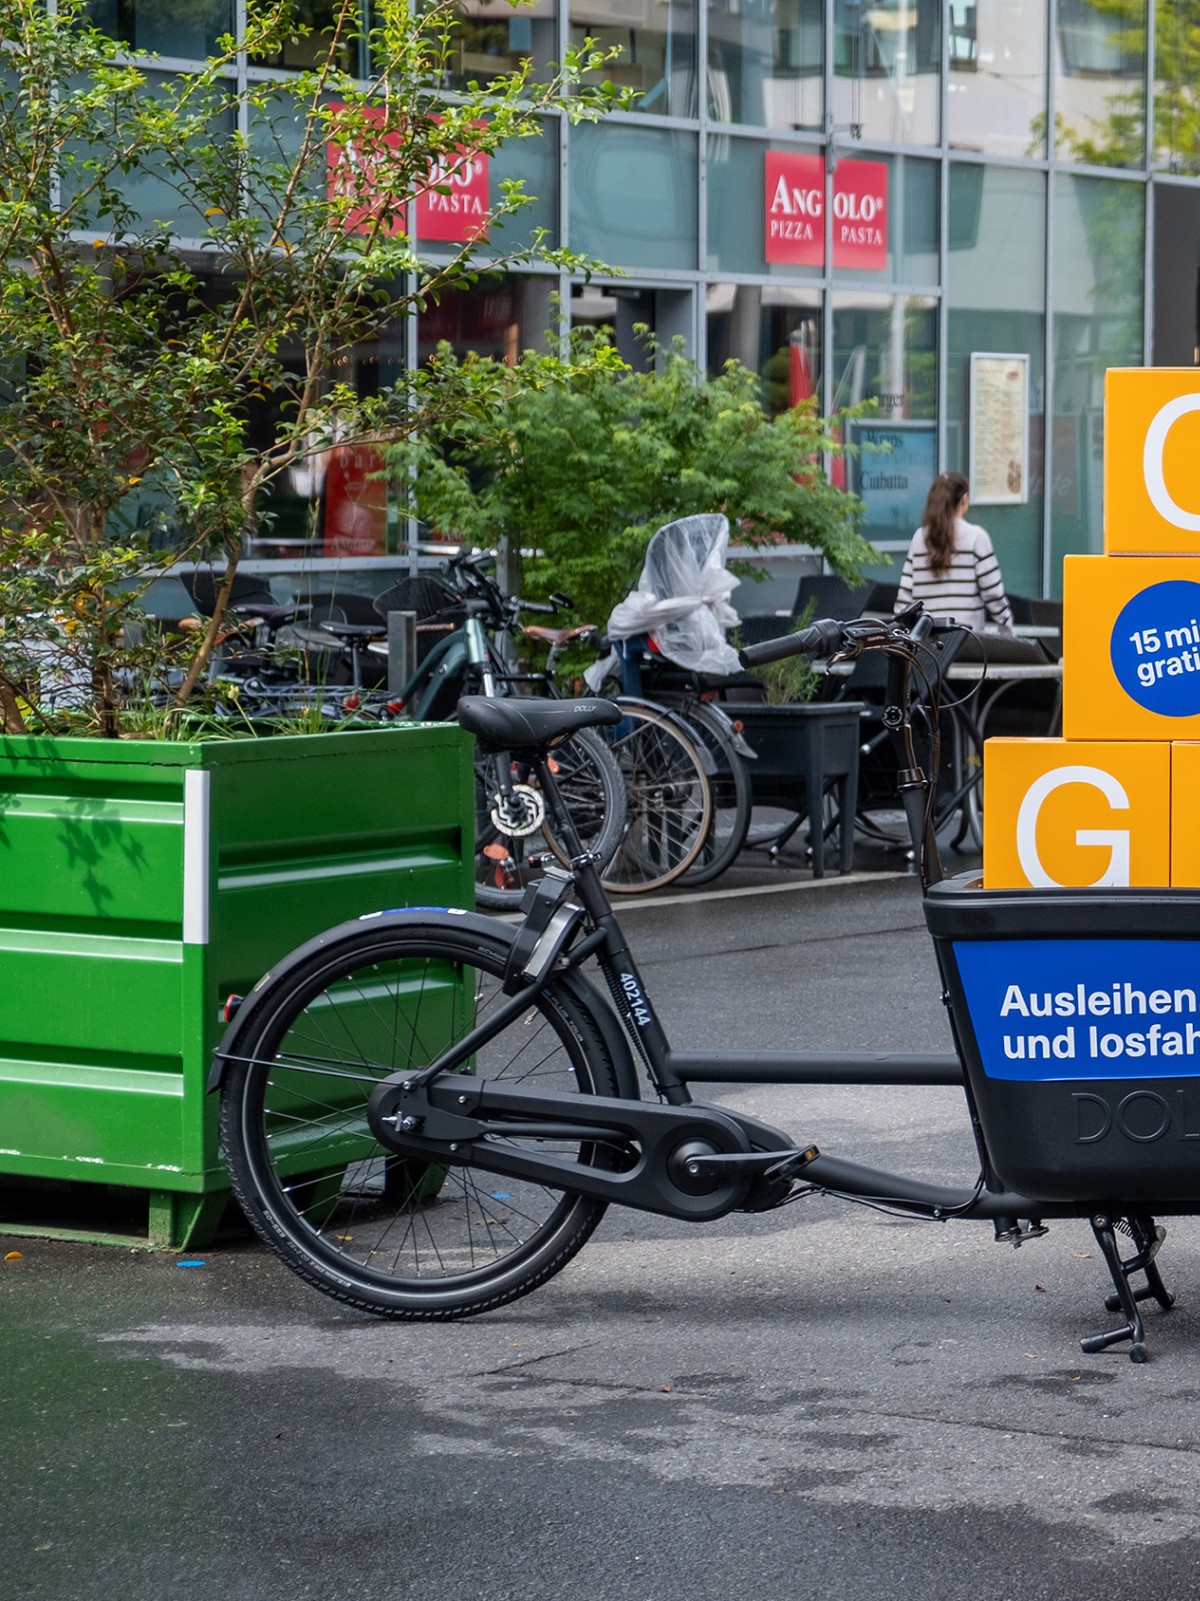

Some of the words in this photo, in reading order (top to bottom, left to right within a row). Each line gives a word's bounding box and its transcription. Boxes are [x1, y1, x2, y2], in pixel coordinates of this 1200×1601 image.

[428, 192, 483, 214] PASTA
[770, 220, 814, 241] PIZZA
[841, 225, 883, 246] PASTA
[859, 470, 909, 490] Ciabatta
[1129, 628, 1161, 655] 15
[1016, 765, 1130, 887] G
[620, 973, 651, 1026] 402144
[1003, 1027, 1075, 1059] und
